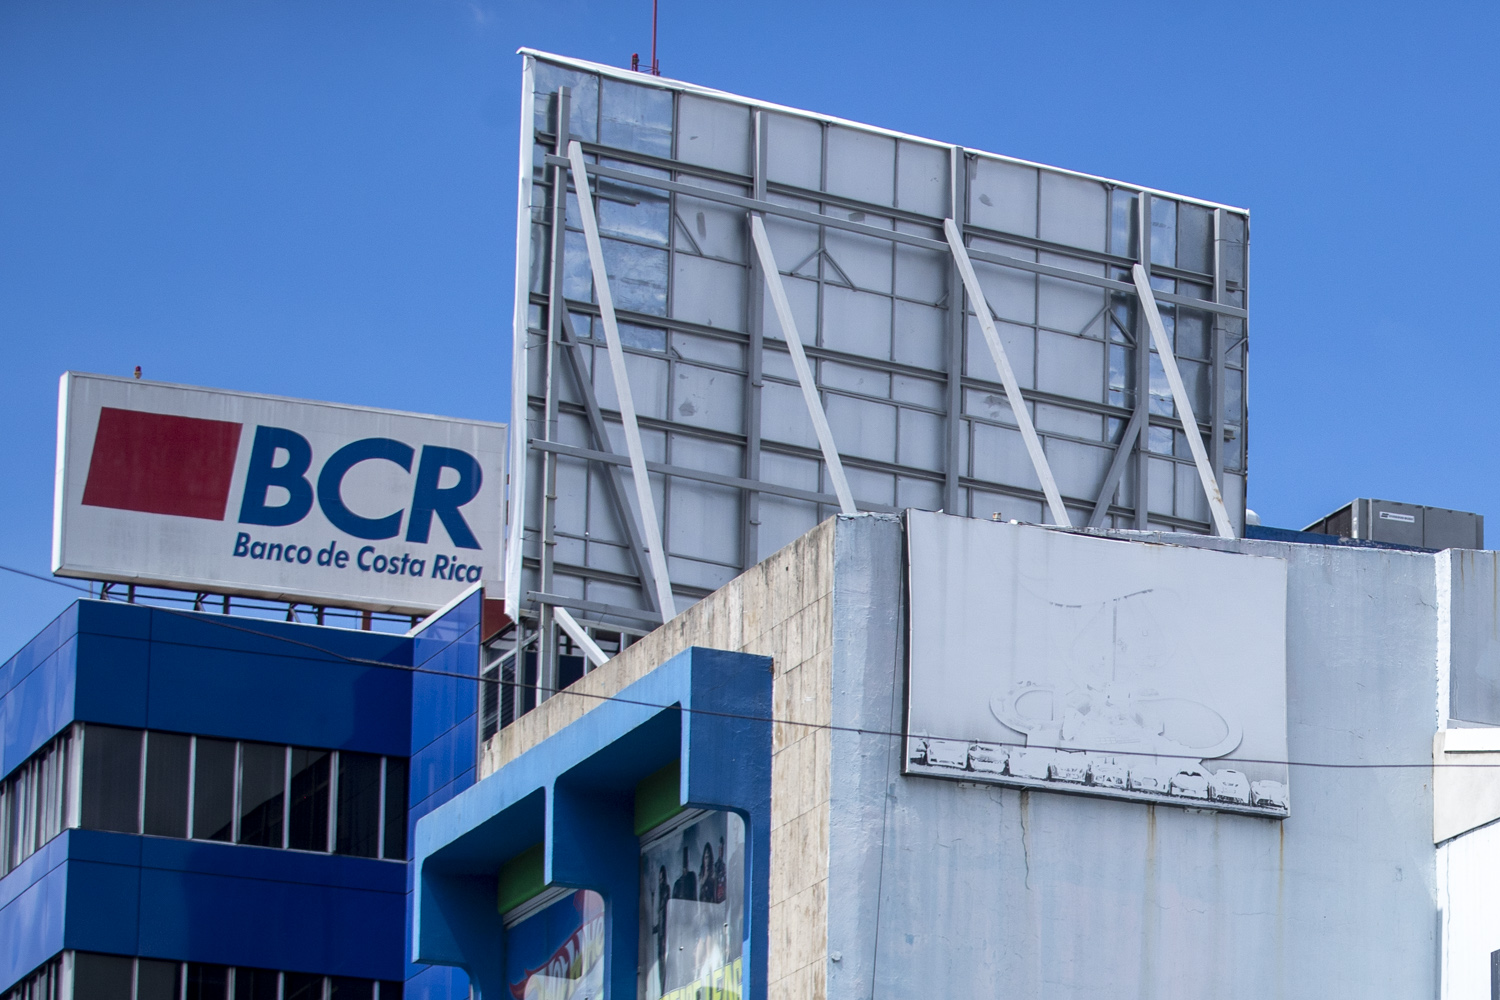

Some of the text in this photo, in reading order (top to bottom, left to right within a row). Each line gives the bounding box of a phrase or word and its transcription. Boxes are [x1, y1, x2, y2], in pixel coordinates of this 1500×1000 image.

[238, 425, 483, 550] BCR
[232, 531, 483, 583] Banco de Costa Rica
